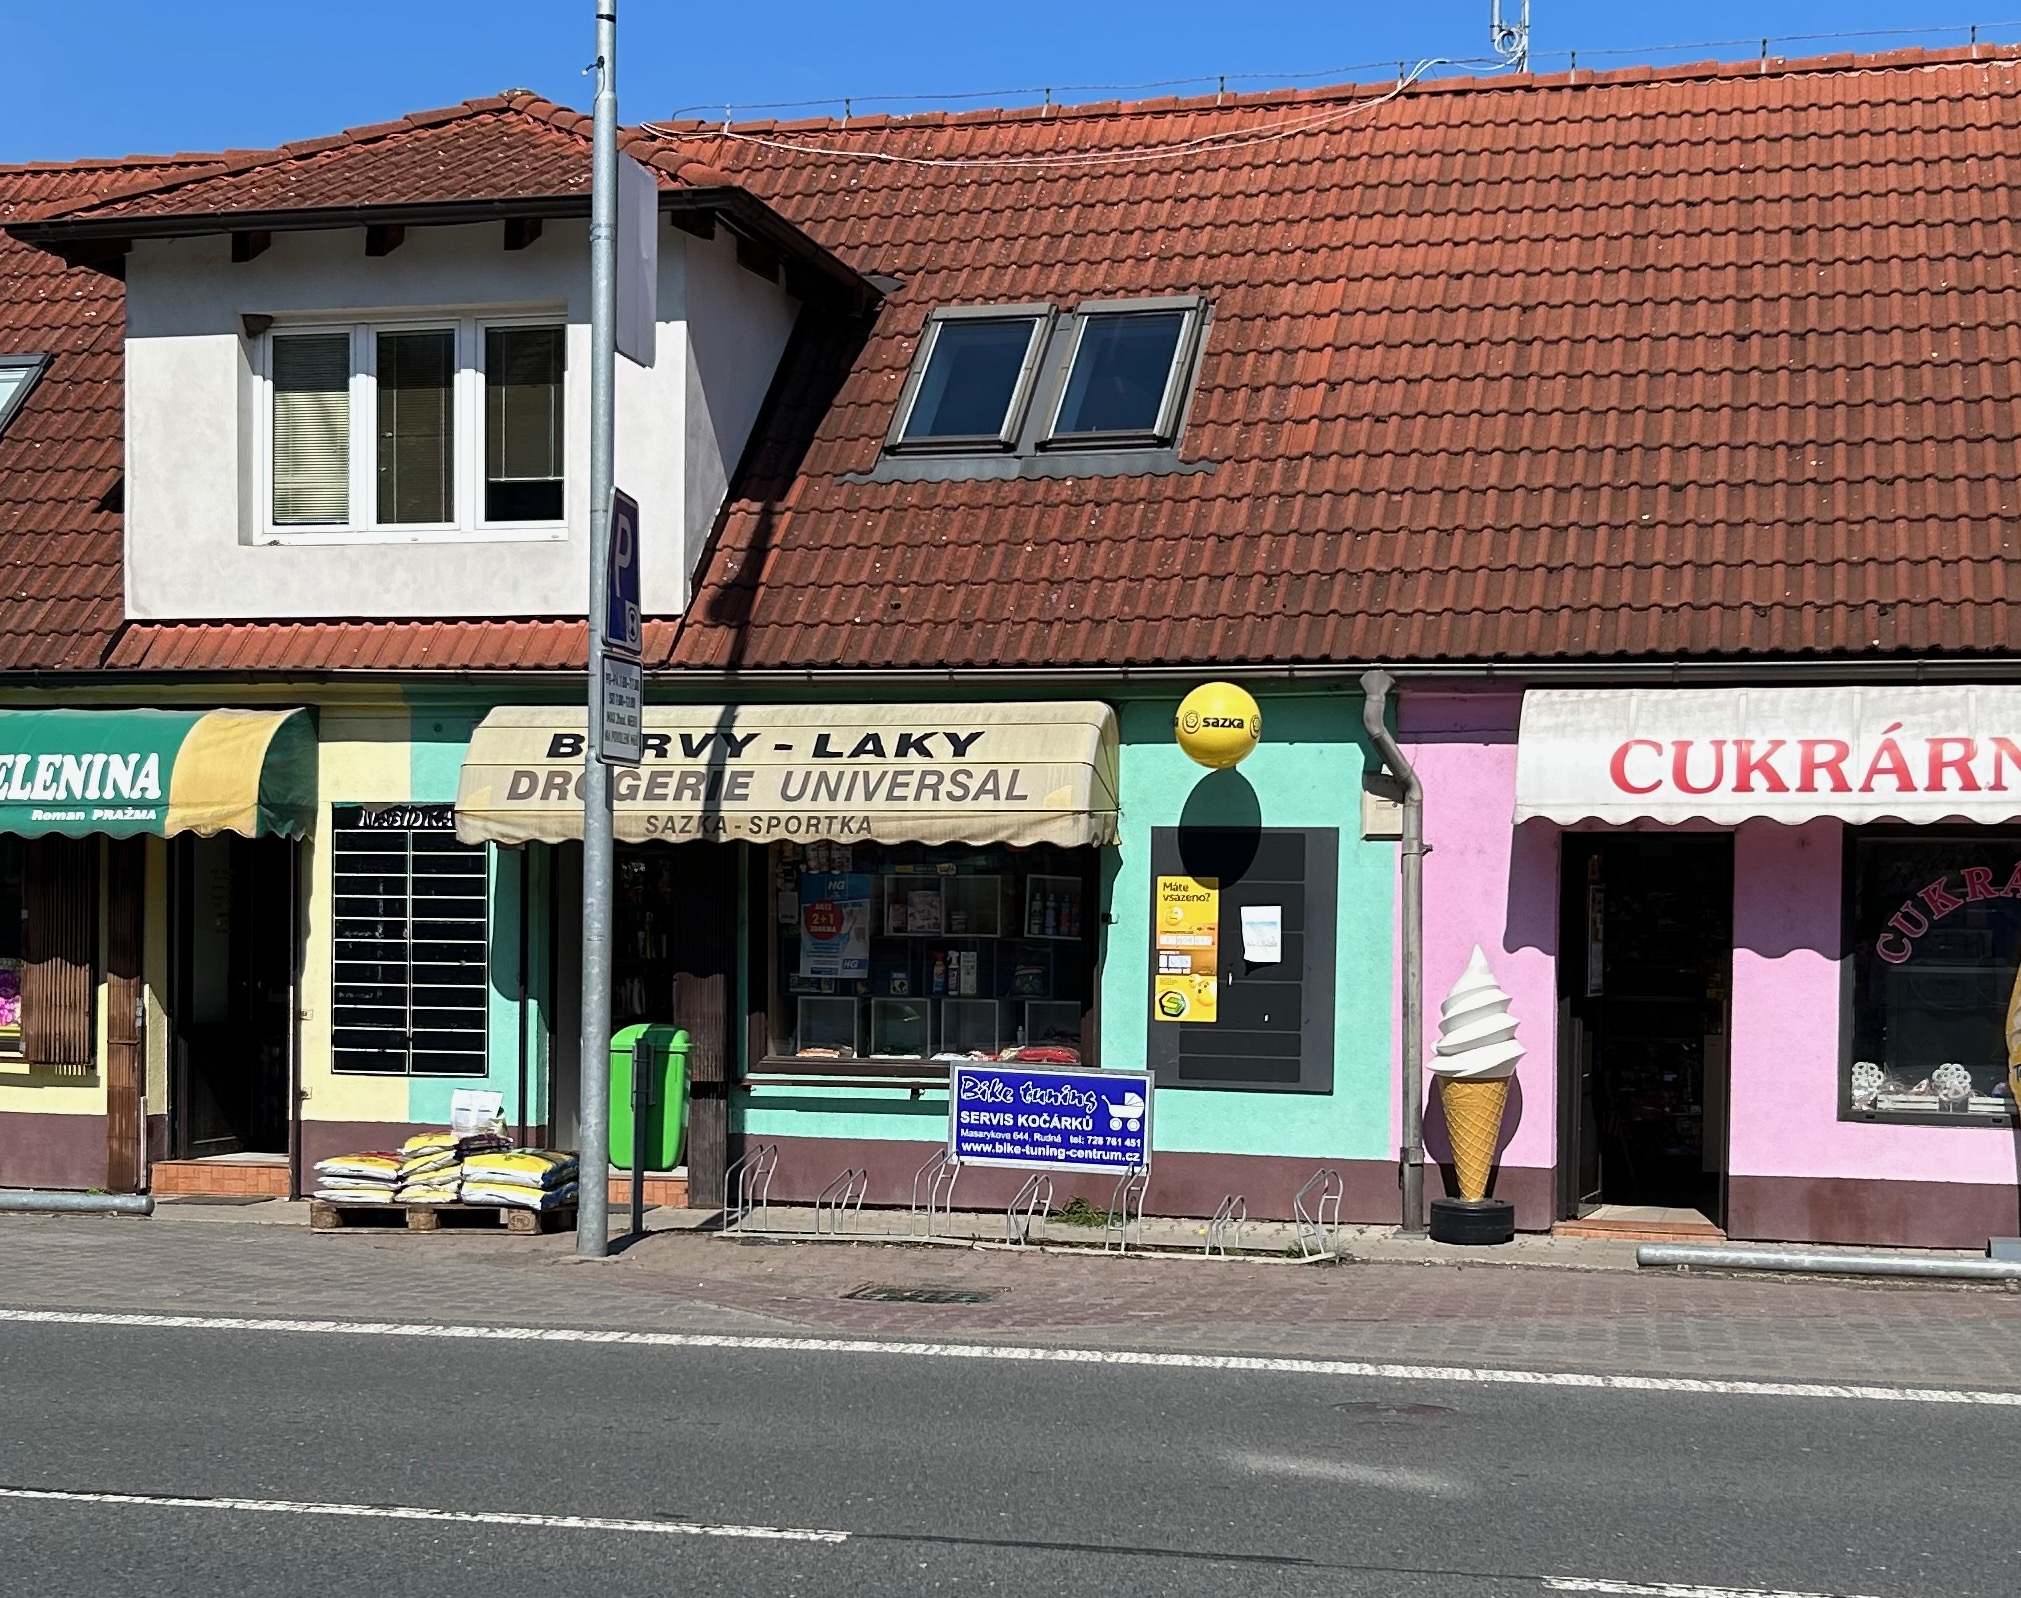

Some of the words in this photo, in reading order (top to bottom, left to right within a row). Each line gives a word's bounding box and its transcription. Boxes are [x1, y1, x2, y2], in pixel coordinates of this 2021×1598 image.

[615, 513, 632, 597] P
[1202, 717, 1244, 729] sazka
[546, 733, 761, 758] BRVY
[812, 731, 985, 758] LAKY
[781, 768, 1028, 801] UNIVERSAL
[31, 809, 86, 820] Roman
[92, 807, 157, 820] PRAŽMA
[645, 815, 728, 835] SAZKA
[748, 815, 873, 835] SPORTKA
[827, 880, 845, 890] HG
[1163, 882, 1189, 892] Máte
[1163, 893, 1211, 902] vsazeno?
[812, 914, 834, 924] 2+1
[843, 959, 860, 968] HG
[960, 1075, 1014, 1103] Bike
[1020, 1081, 1098, 1114] tuning
[960, 1111, 1014, 1126] SERVIS
[1017, 1112, 1093, 1131] KOČÁRKŮ
[960, 1128, 1011, 1140] Masarykova
[1033, 1132, 1062, 1142] Rudná
[1070, 1134, 1085, 1144] tel:
[1124, 1138, 1141, 1148] 451
[961, 1142, 1140, 1162] www.bike-tuning-centrum.cz
